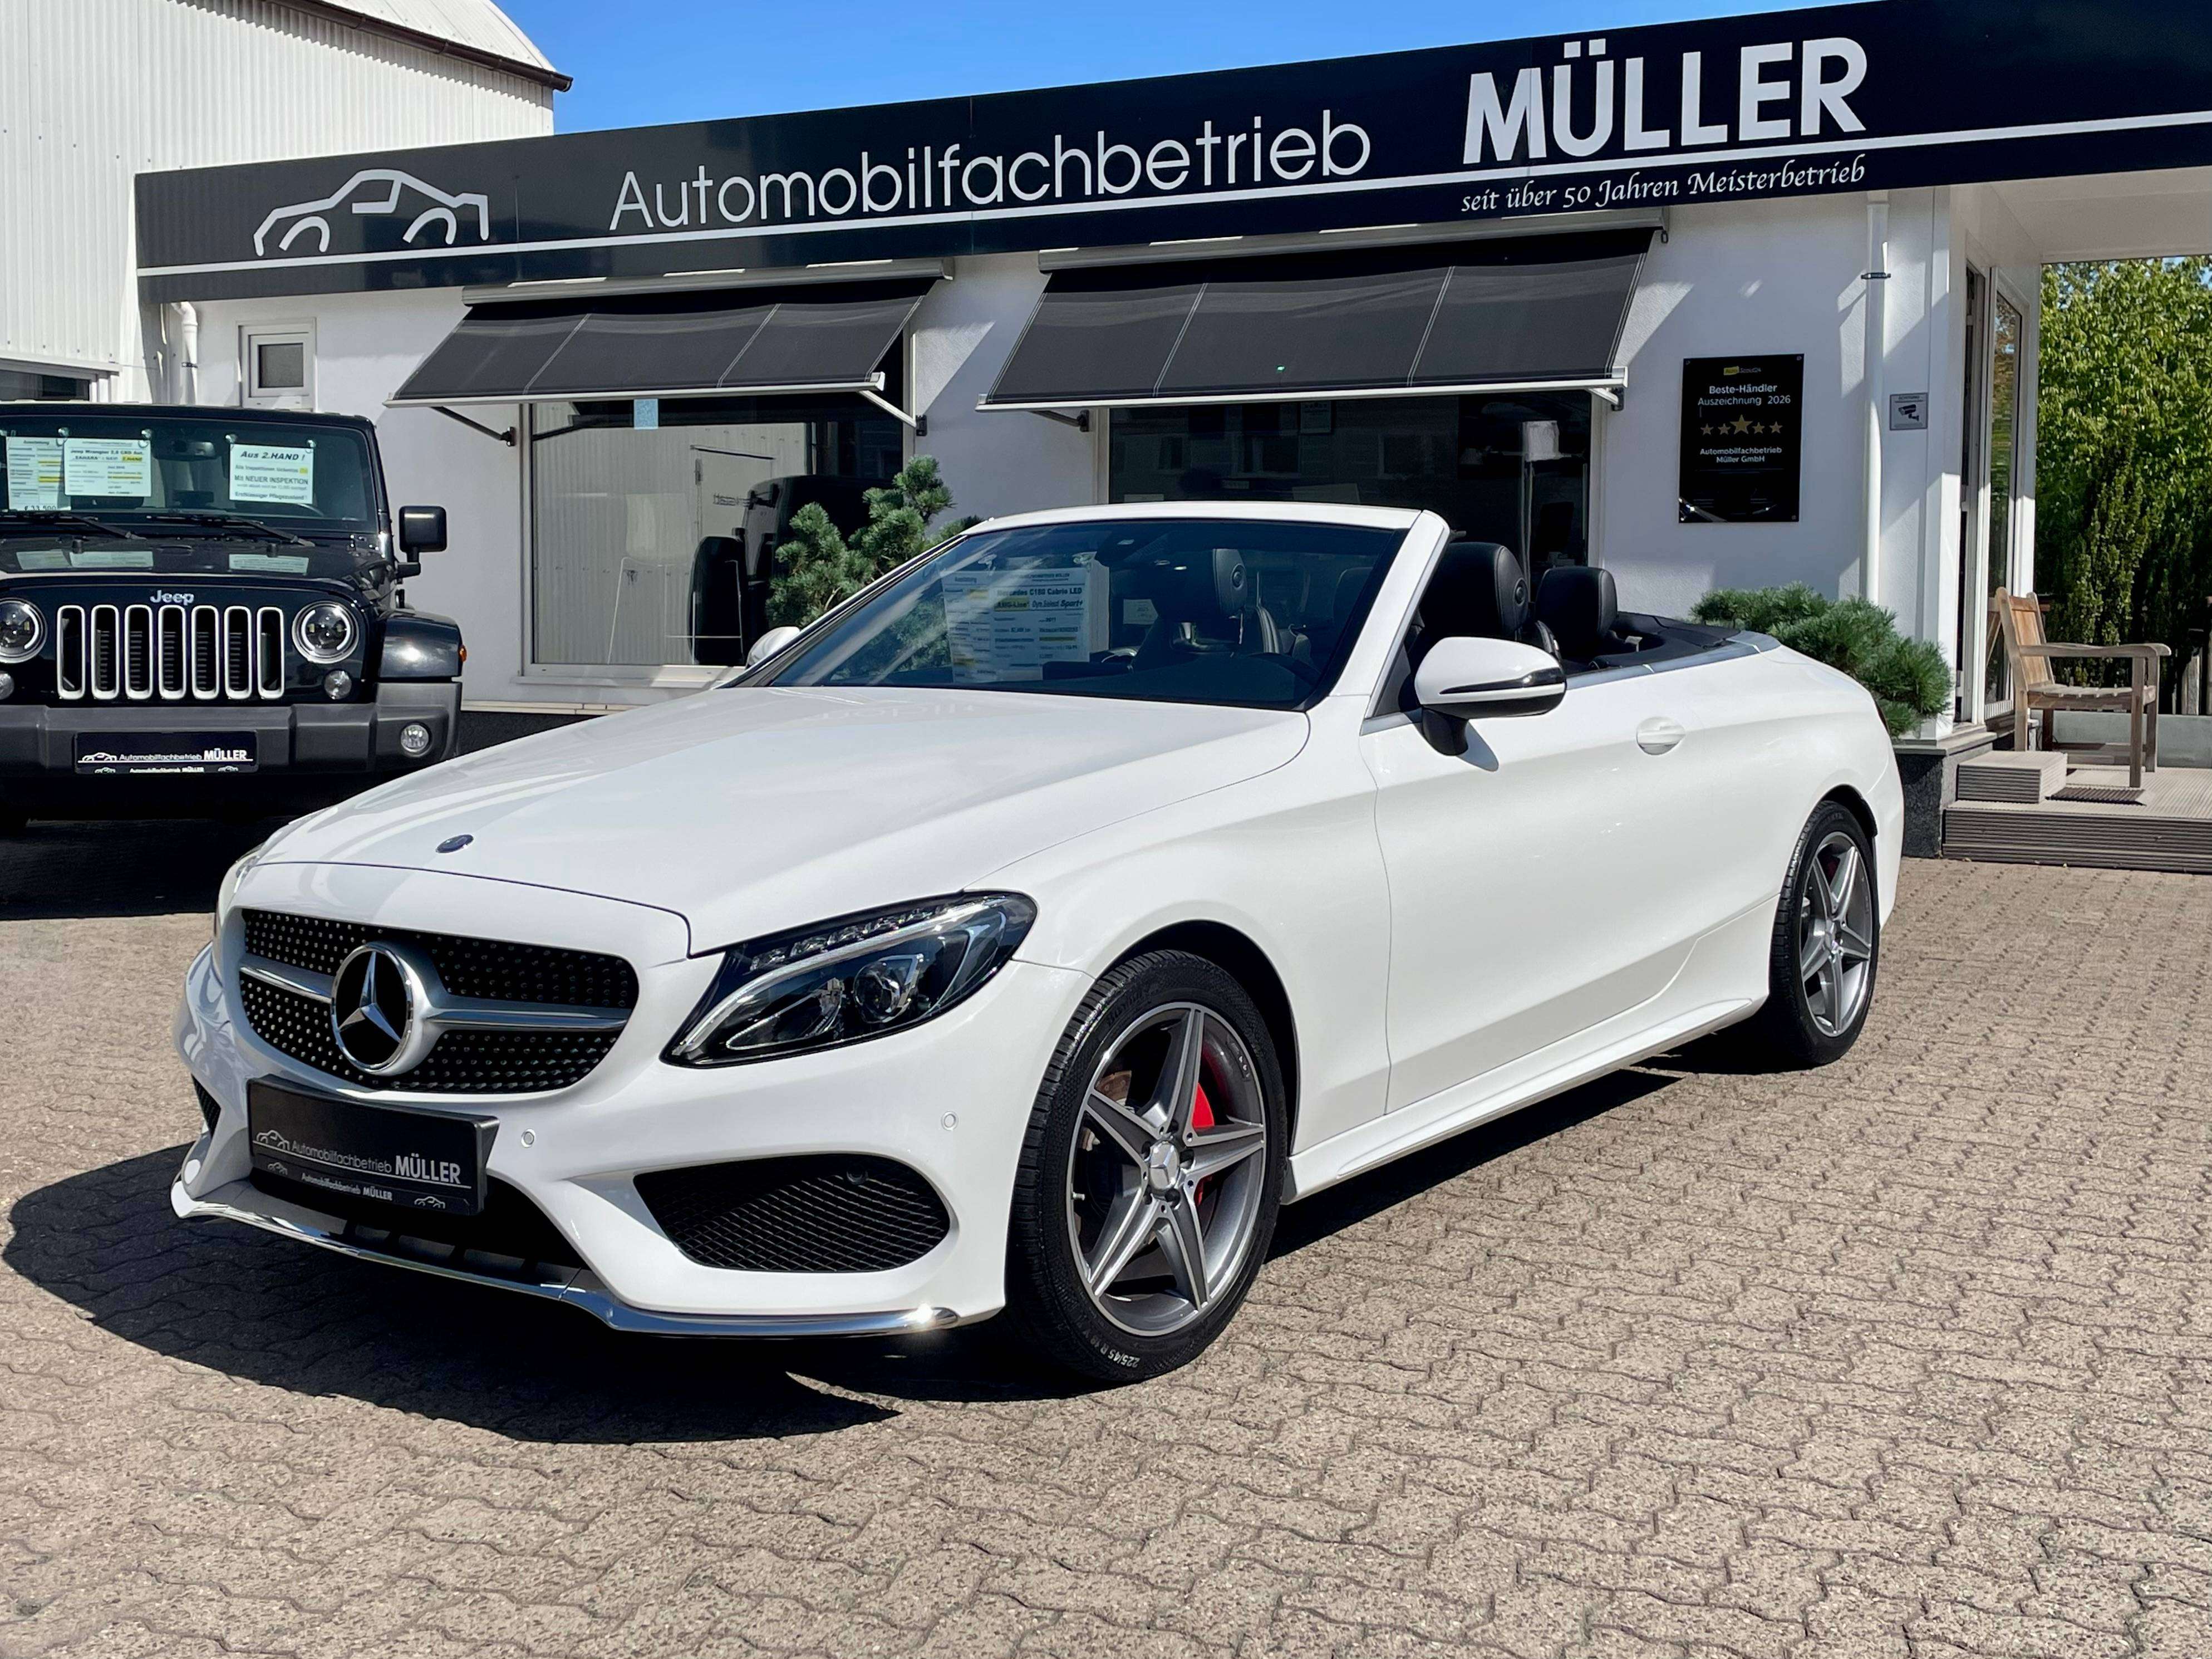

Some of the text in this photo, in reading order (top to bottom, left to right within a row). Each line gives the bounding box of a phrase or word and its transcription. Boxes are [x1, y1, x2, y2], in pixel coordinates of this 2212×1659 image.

[608, 37, 1867, 231] Automobilfachbetrieb MÜLLER
[1461, 154, 1865, 212] seit über 50 Jahren Meisterbetrieb
[1709, 384, 1777, 394] Beste-Händler
[1698, 395, 1791, 406] Auszeichnung 2026
[1700, 447, 1782, 455] Automobilfachbetrieb
[150, 590, 194, 606] Jeep
[1060, 600, 1083, 608] Sport+
[204, 748, 247, 760] MÜLLER
[291, 1140, 461, 1185] Automobilfachbetrieb MÜLLER
[363, 1186, 393, 1201] MÜLLER
[1108, 1349, 1141, 1368] 225/45
